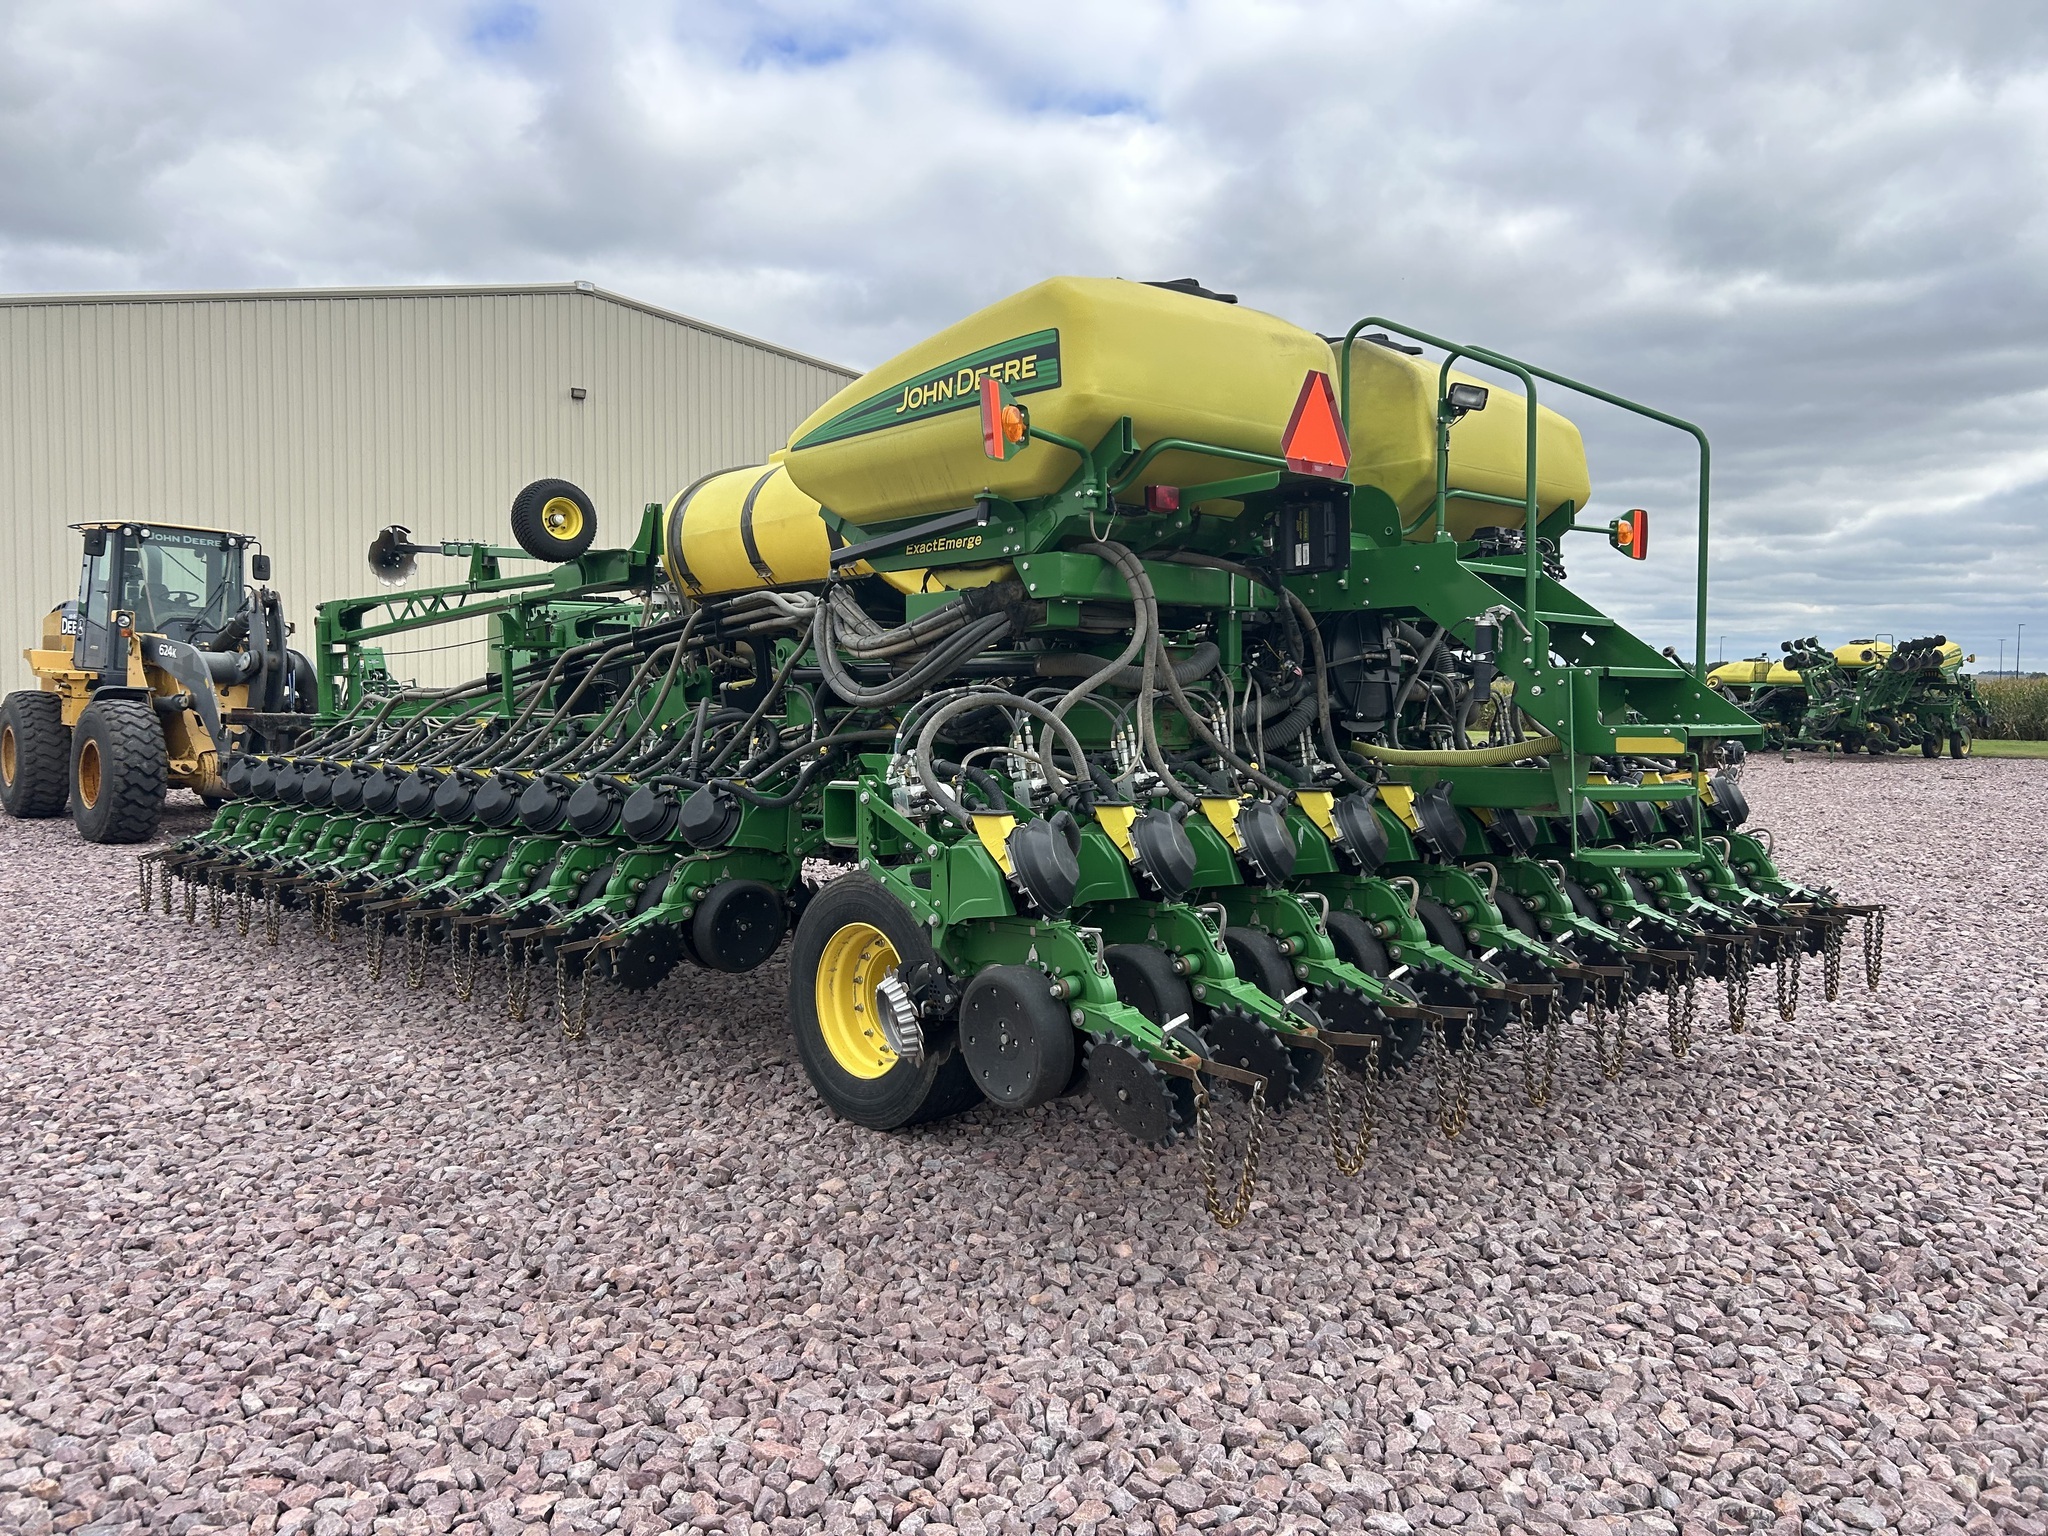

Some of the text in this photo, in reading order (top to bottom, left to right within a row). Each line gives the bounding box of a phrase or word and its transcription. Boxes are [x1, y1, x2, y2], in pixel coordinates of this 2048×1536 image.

[896, 354, 1037, 413] JOHN DEERE
[148, 532, 222, 547] JOHN DEERE
[905, 535, 982, 556] ExactEmerge
